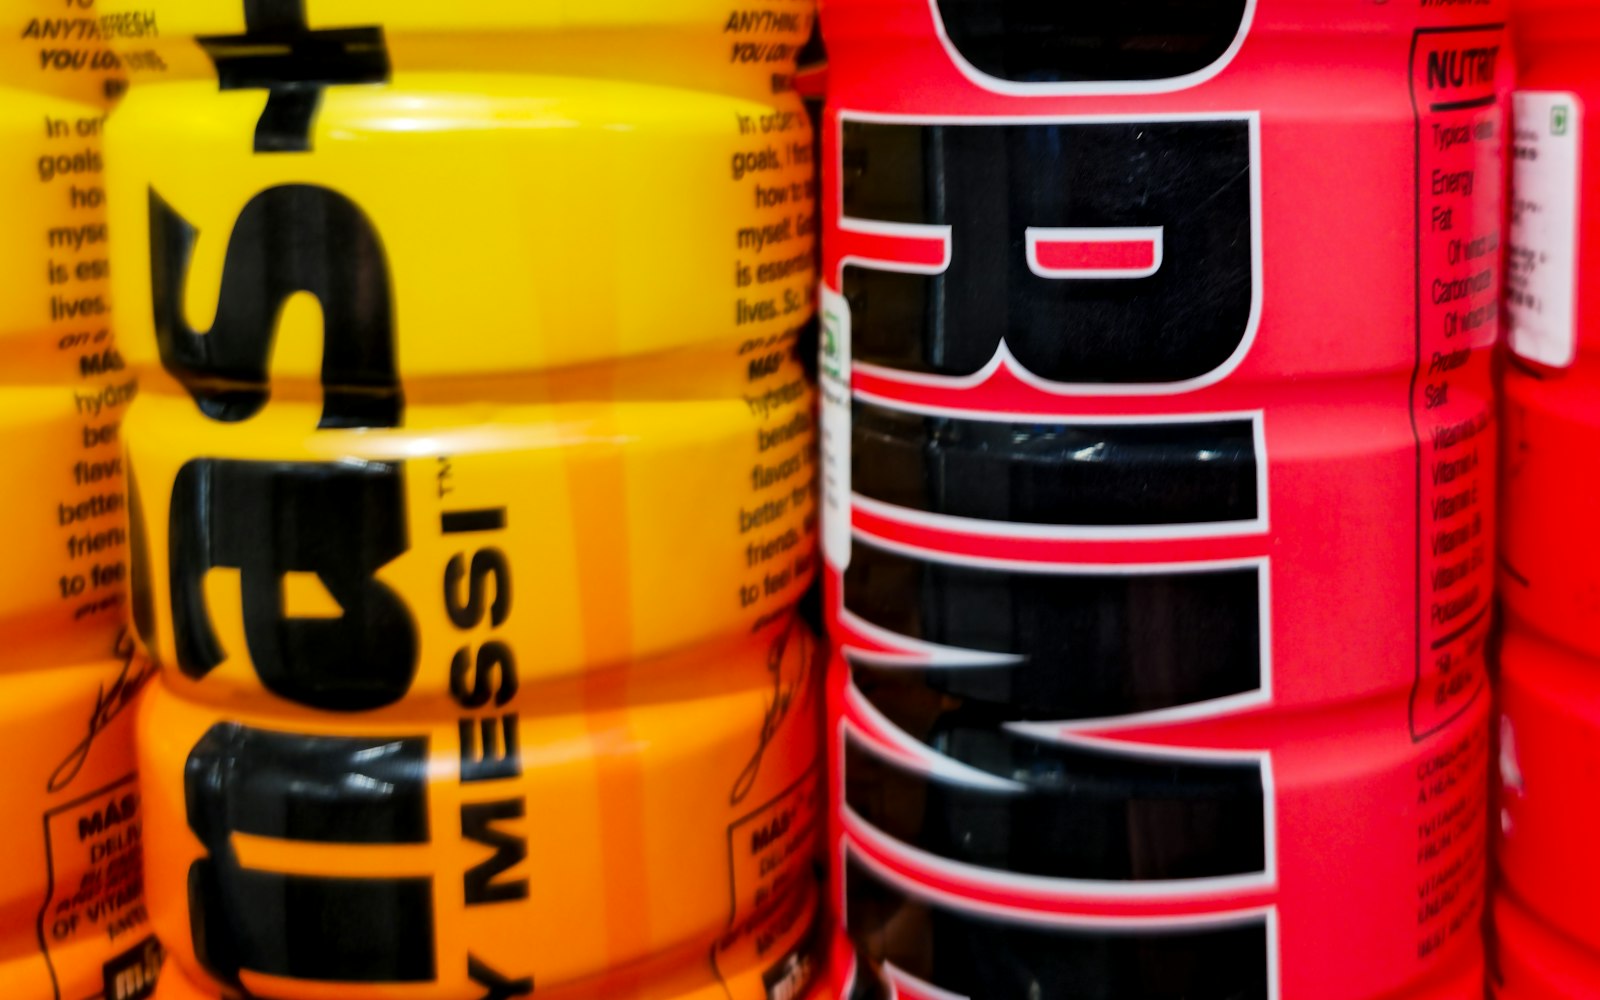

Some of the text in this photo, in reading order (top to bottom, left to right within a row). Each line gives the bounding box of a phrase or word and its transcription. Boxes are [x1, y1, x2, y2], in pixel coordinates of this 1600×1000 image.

[40, 49, 88, 71] YOU
[1431, 168, 1475, 197] Energy
[1431, 205, 1453, 232] Fat
[440, 506, 531, 908] MESSI
